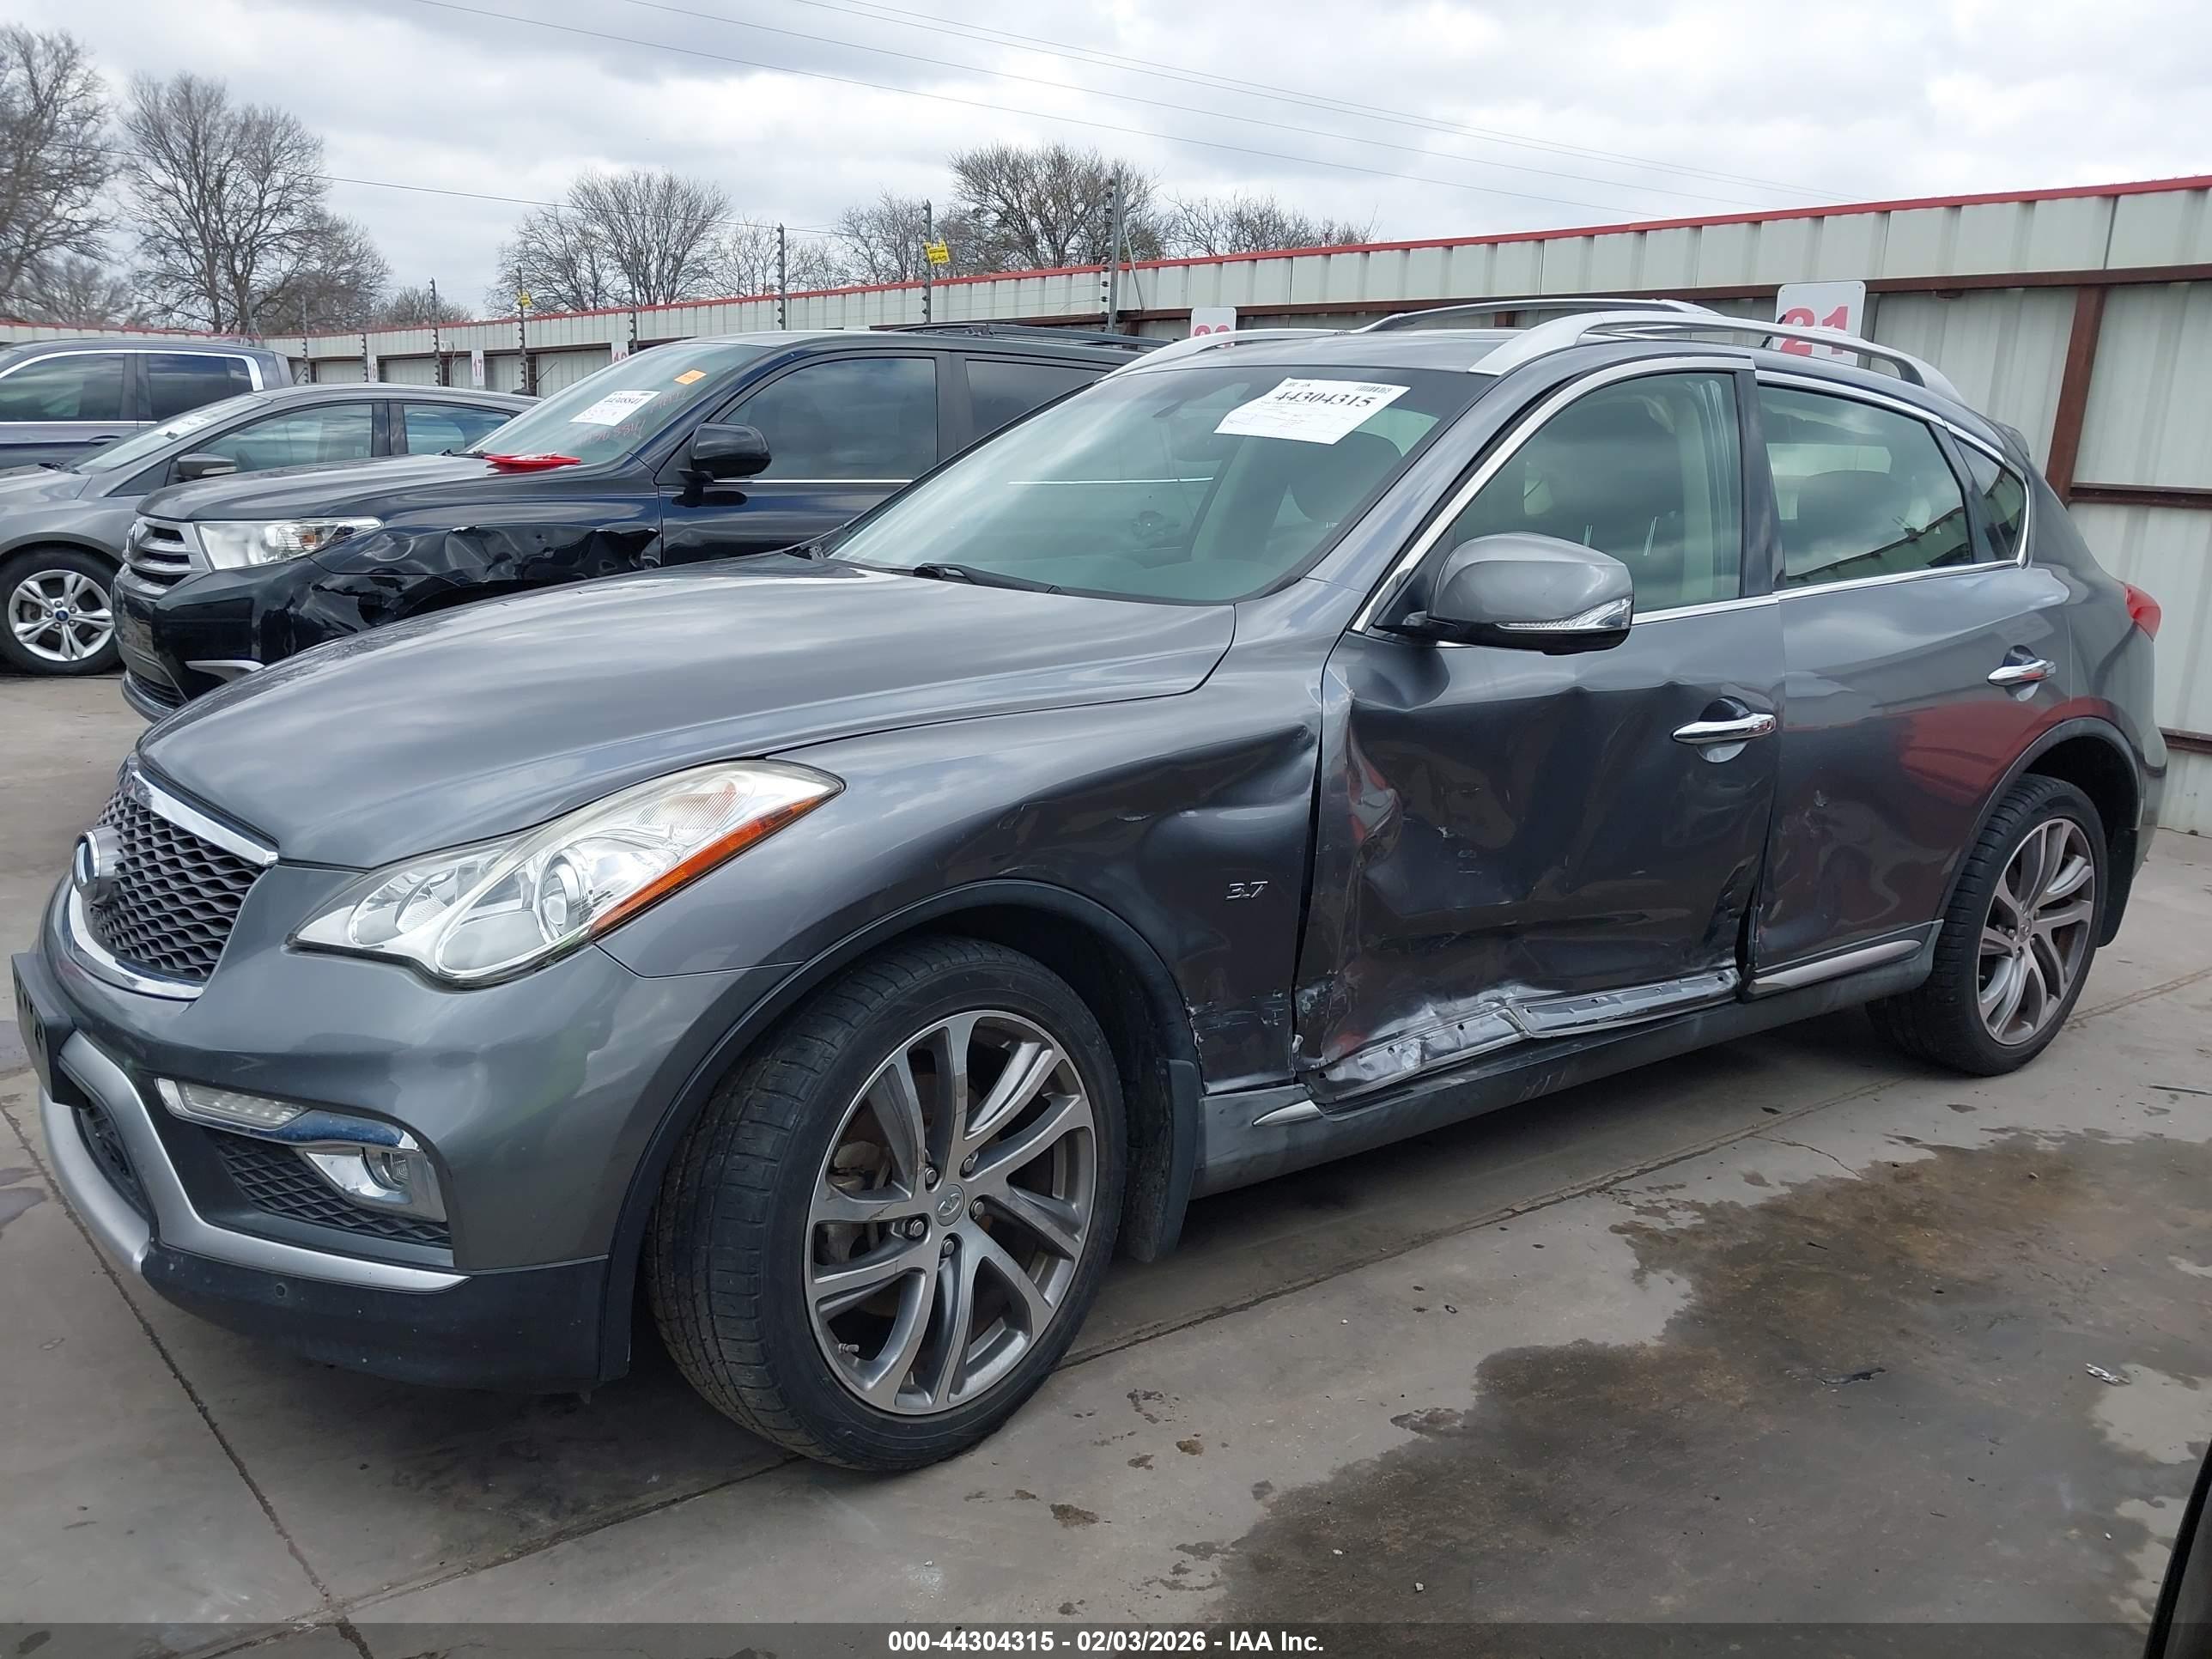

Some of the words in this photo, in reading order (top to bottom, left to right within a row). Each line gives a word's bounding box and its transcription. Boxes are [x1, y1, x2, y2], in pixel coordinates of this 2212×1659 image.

[1779, 305, 1849, 357] 21
[472, 357, 483, 378] 17
[1274, 391, 1377, 408] 44304315
[1225, 880, 1269, 901] 3.7
